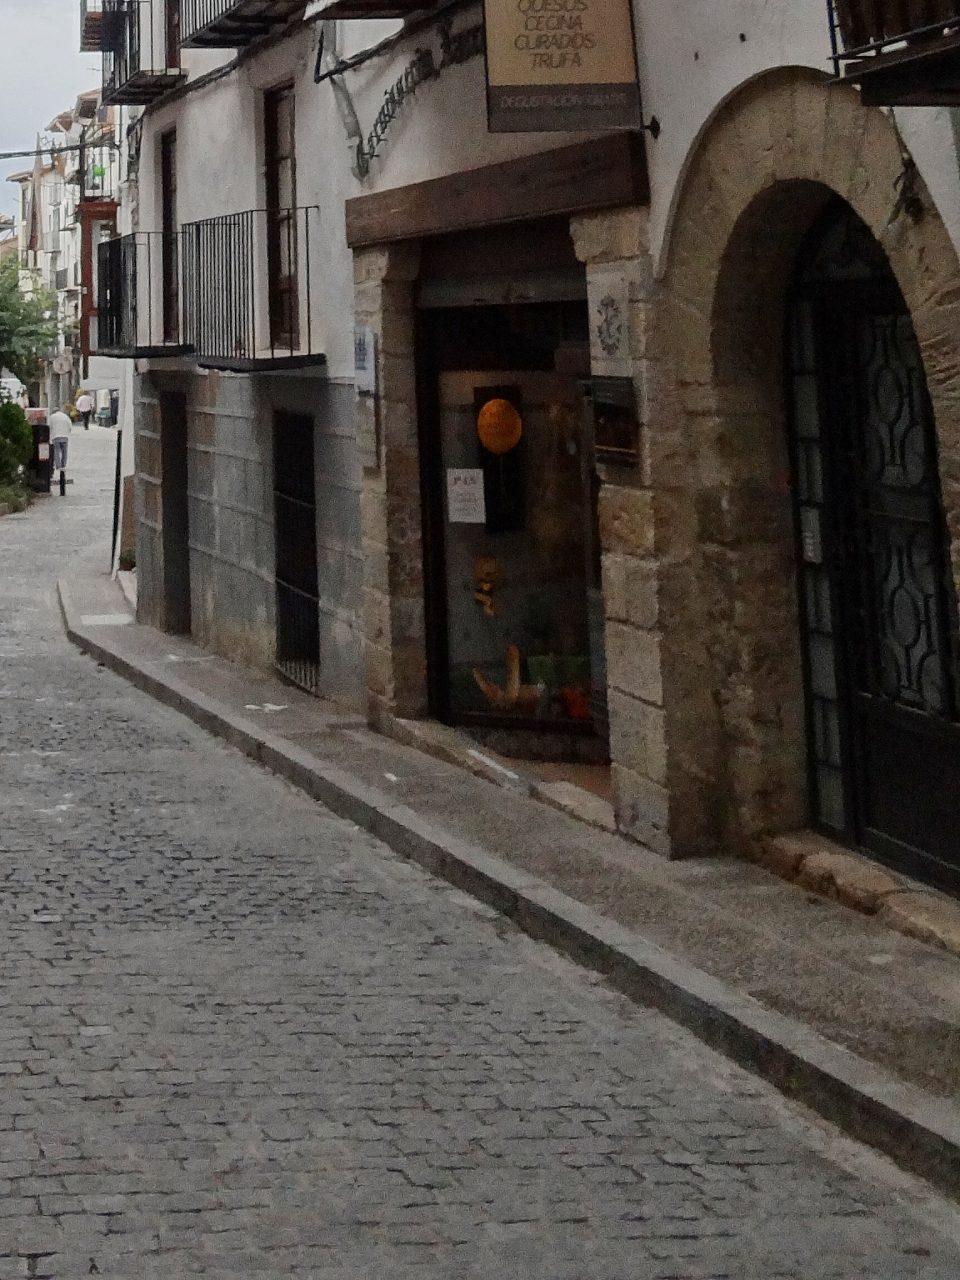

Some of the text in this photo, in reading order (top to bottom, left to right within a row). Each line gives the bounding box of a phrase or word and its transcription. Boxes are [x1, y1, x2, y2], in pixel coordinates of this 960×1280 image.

[524, 14, 583, 31] CECINA
[513, 32, 598, 51] CURADOS
[529, 52, 583, 69] TRUFA
